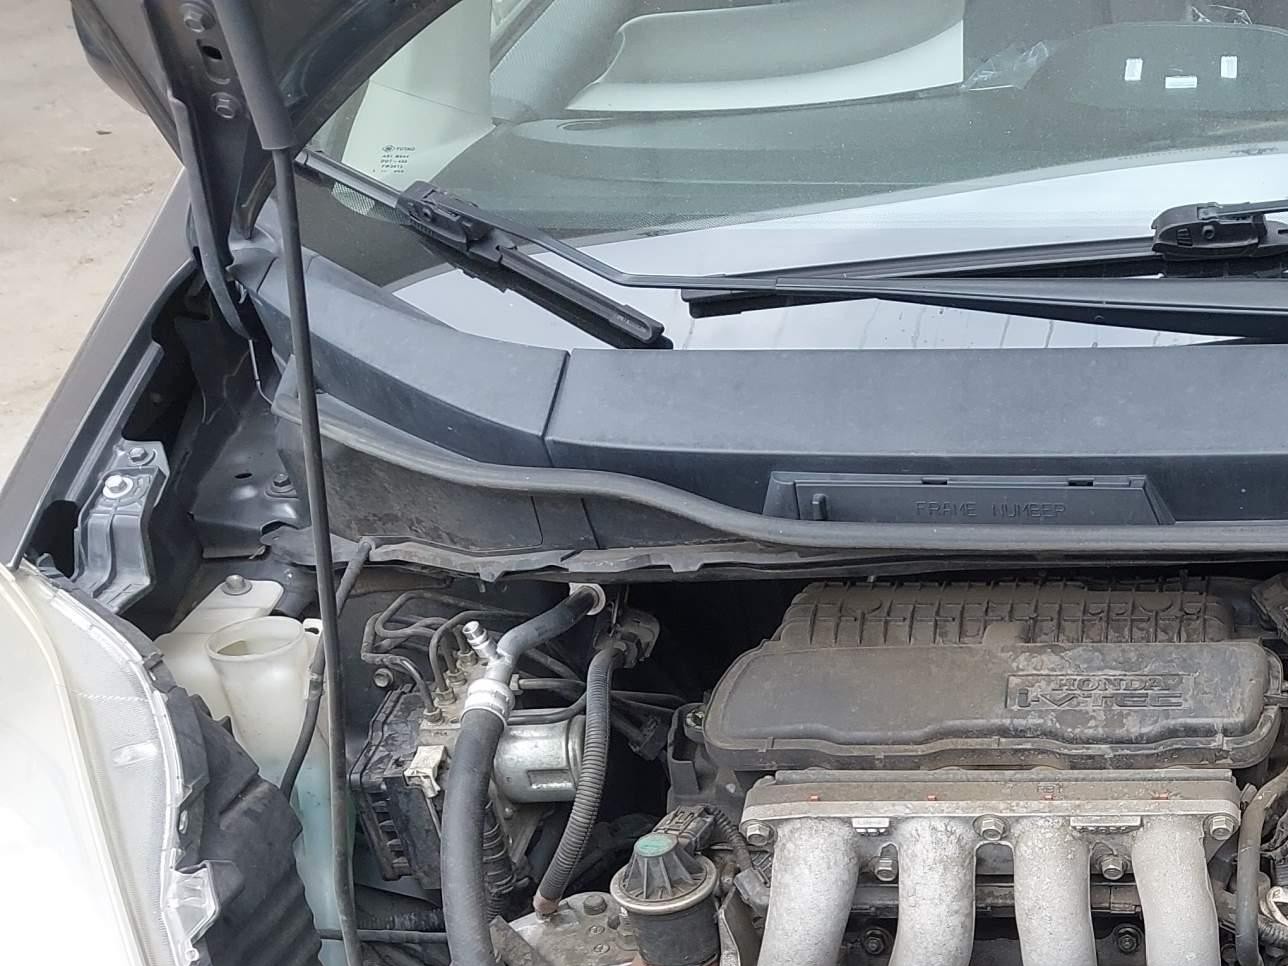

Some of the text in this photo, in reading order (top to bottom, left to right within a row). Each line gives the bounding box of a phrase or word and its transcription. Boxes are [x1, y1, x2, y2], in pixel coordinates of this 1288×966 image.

[915, 501, 1066, 518] FRAME NUMBER
[1051, 677, 1170, 692] HONDA
[1016, 687, 1184, 708] i-VTEC
